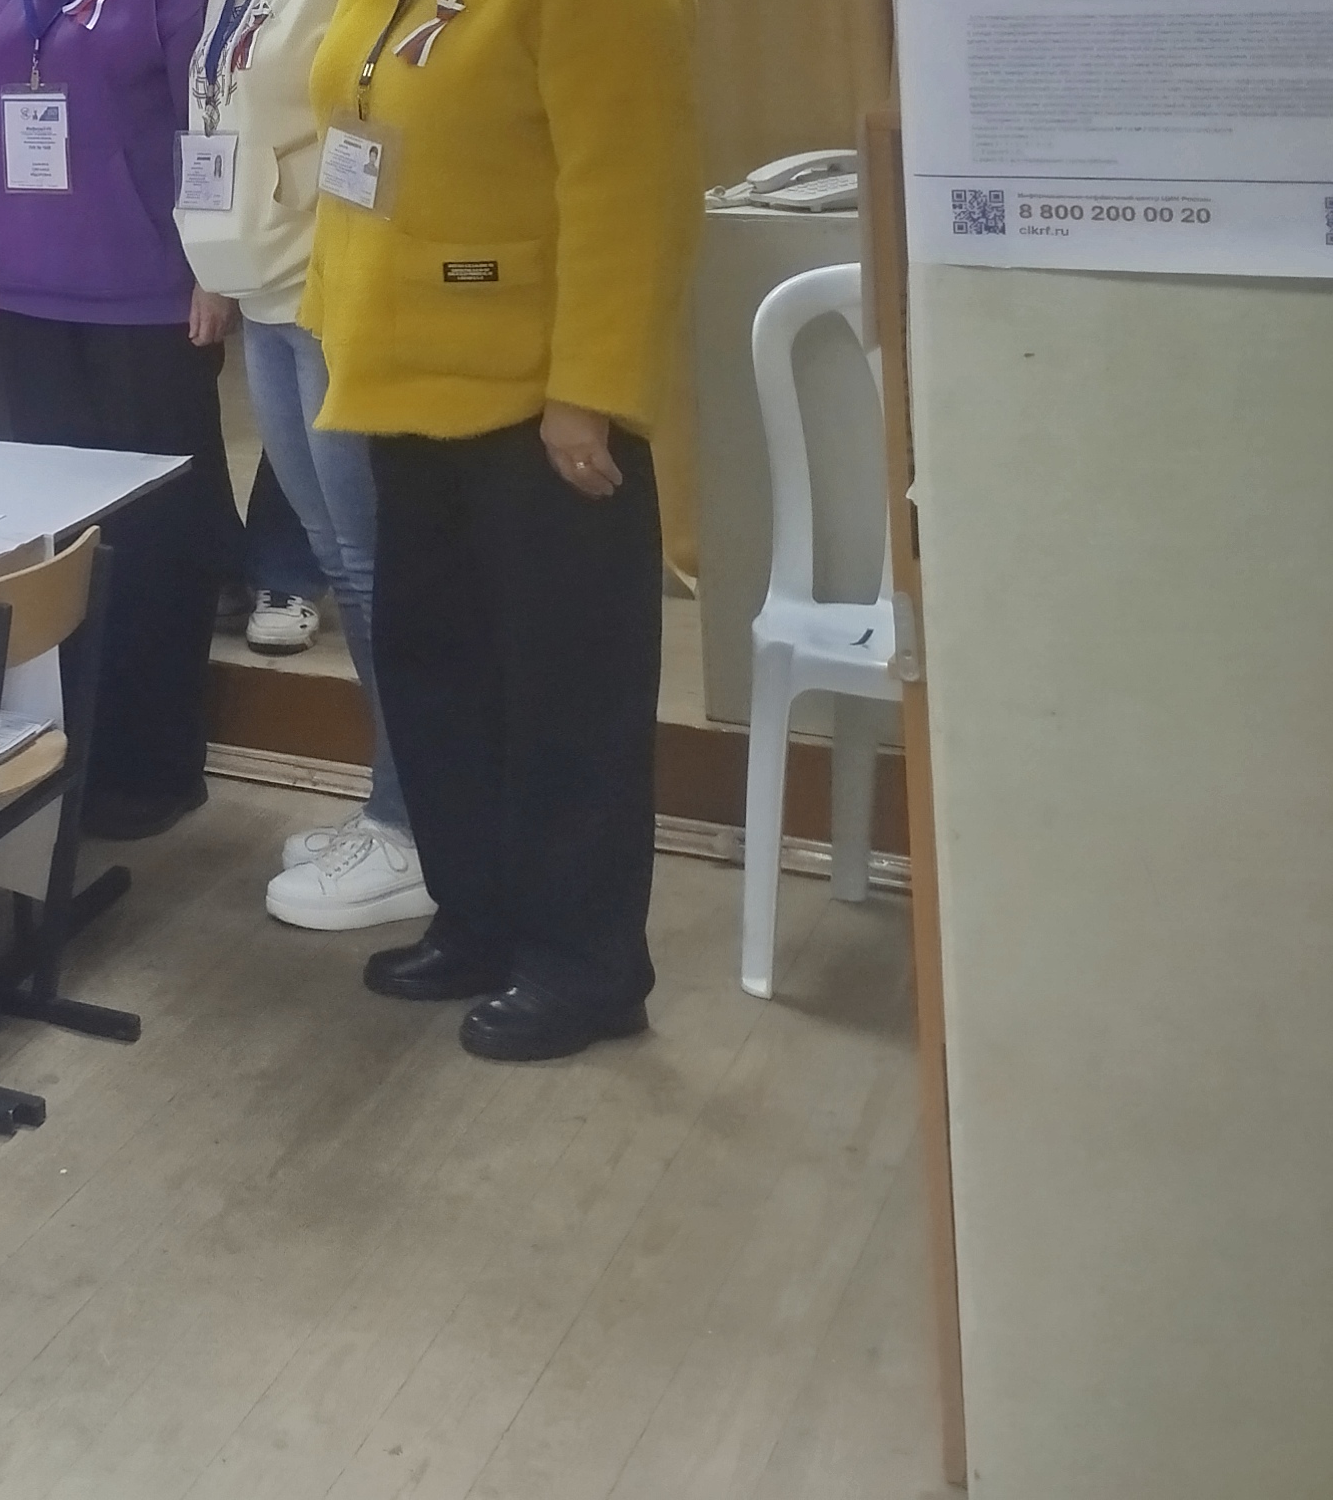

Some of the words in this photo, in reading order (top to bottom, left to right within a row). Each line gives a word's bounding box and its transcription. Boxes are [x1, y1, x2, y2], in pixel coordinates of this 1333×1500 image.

[1019, 203, 1032, 219] 8
[1039, 204, 1084, 220] 800
[1091, 205, 1136, 222] 200
[1143, 206, 1174, 222] 00
[1180, 207, 1211, 223] 20
